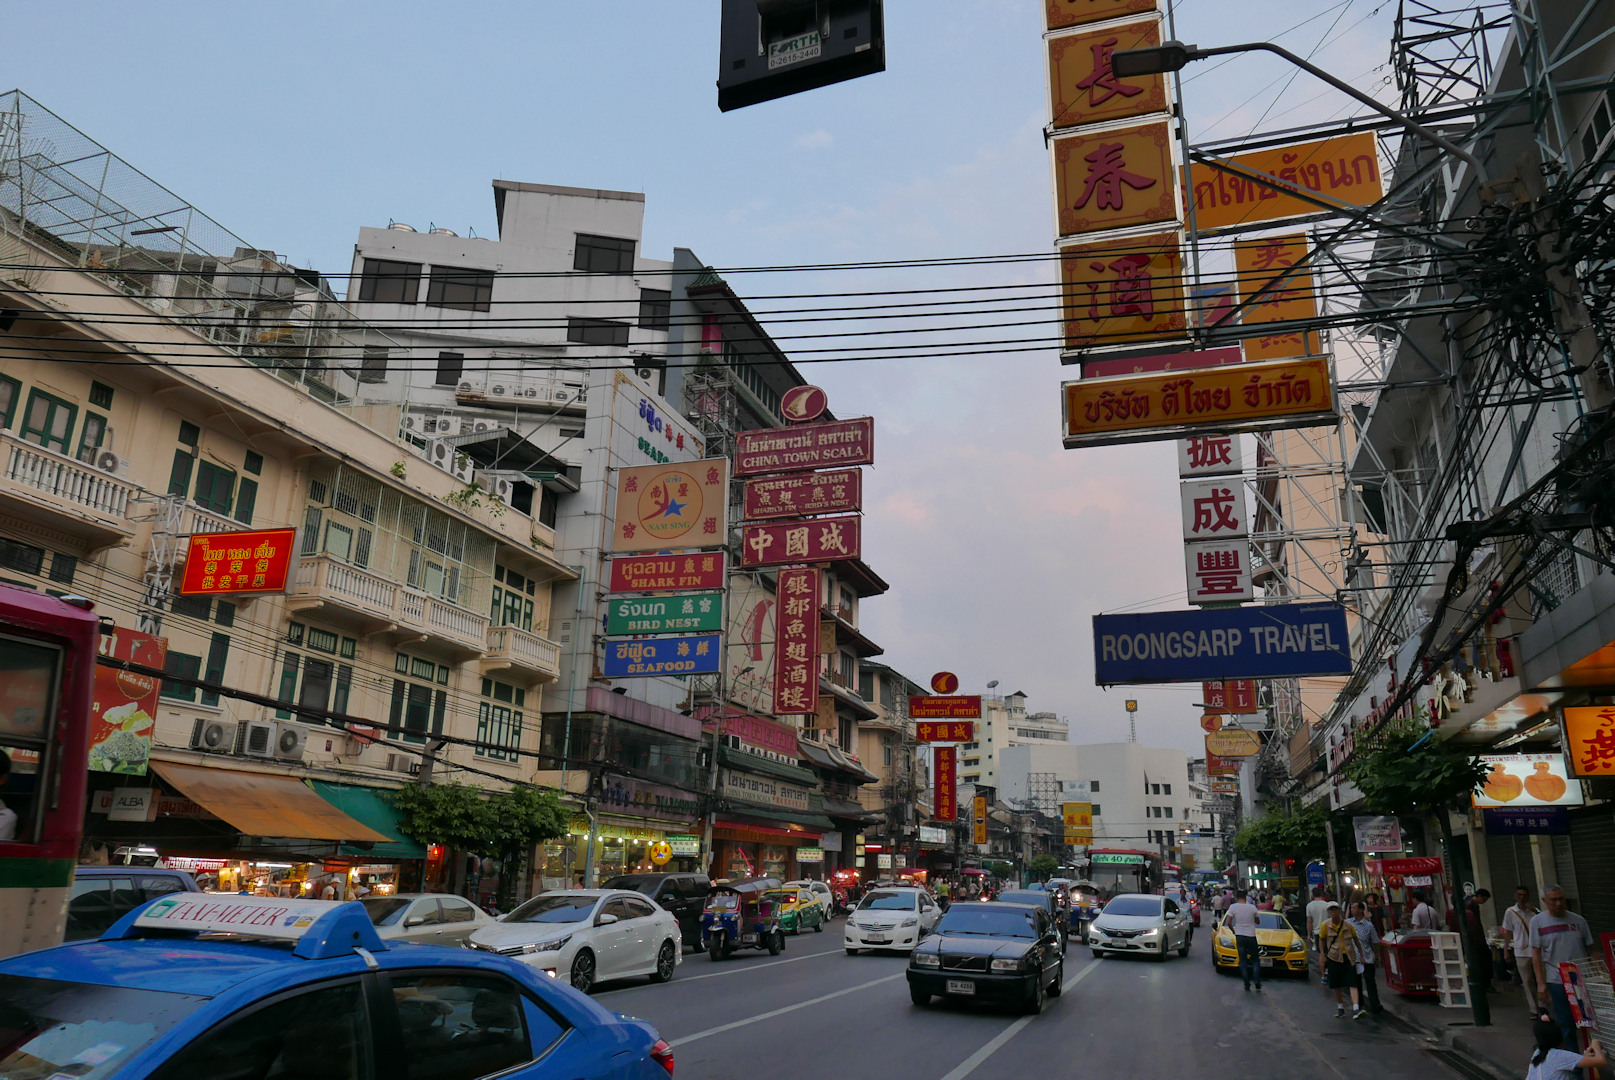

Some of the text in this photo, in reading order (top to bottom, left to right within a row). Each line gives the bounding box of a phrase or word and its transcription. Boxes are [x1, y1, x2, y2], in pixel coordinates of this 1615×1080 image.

[770, 33, 820, 56] FORTH
[770, 48, 819, 67] 0-2615-2440
[1084, 372, 1311, 422] บริษัท ดีไทย จำกัด
[742, 446, 864, 468] CHINA TOWN SCALA
[753, 506, 783, 515] SHARK'S
[805, 501, 829, 509] BIRD'S
[830, 499, 850, 507] NEST
[648, 521, 690, 531] NAM SING
[750, 522, 848, 562] 中國城
[622, 561, 675, 580] หูฉลาม
[631, 576, 702, 588] SHARK FIN
[618, 600, 665, 617] รังนก
[628, 618, 701, 630] BIRD NEST
[780, 575, 813, 709] 銀都魚翅酒樓
[1102, 623, 1340, 661] ROONGSARP TRAVEL
[627, 661, 695, 674] SEAFOOD
[731, 687, 773, 712] SCAL
[920, 724, 967, 740] 中國城
[117, 797, 144, 807] ALBA
[1110, 855, 1123, 863] 40
